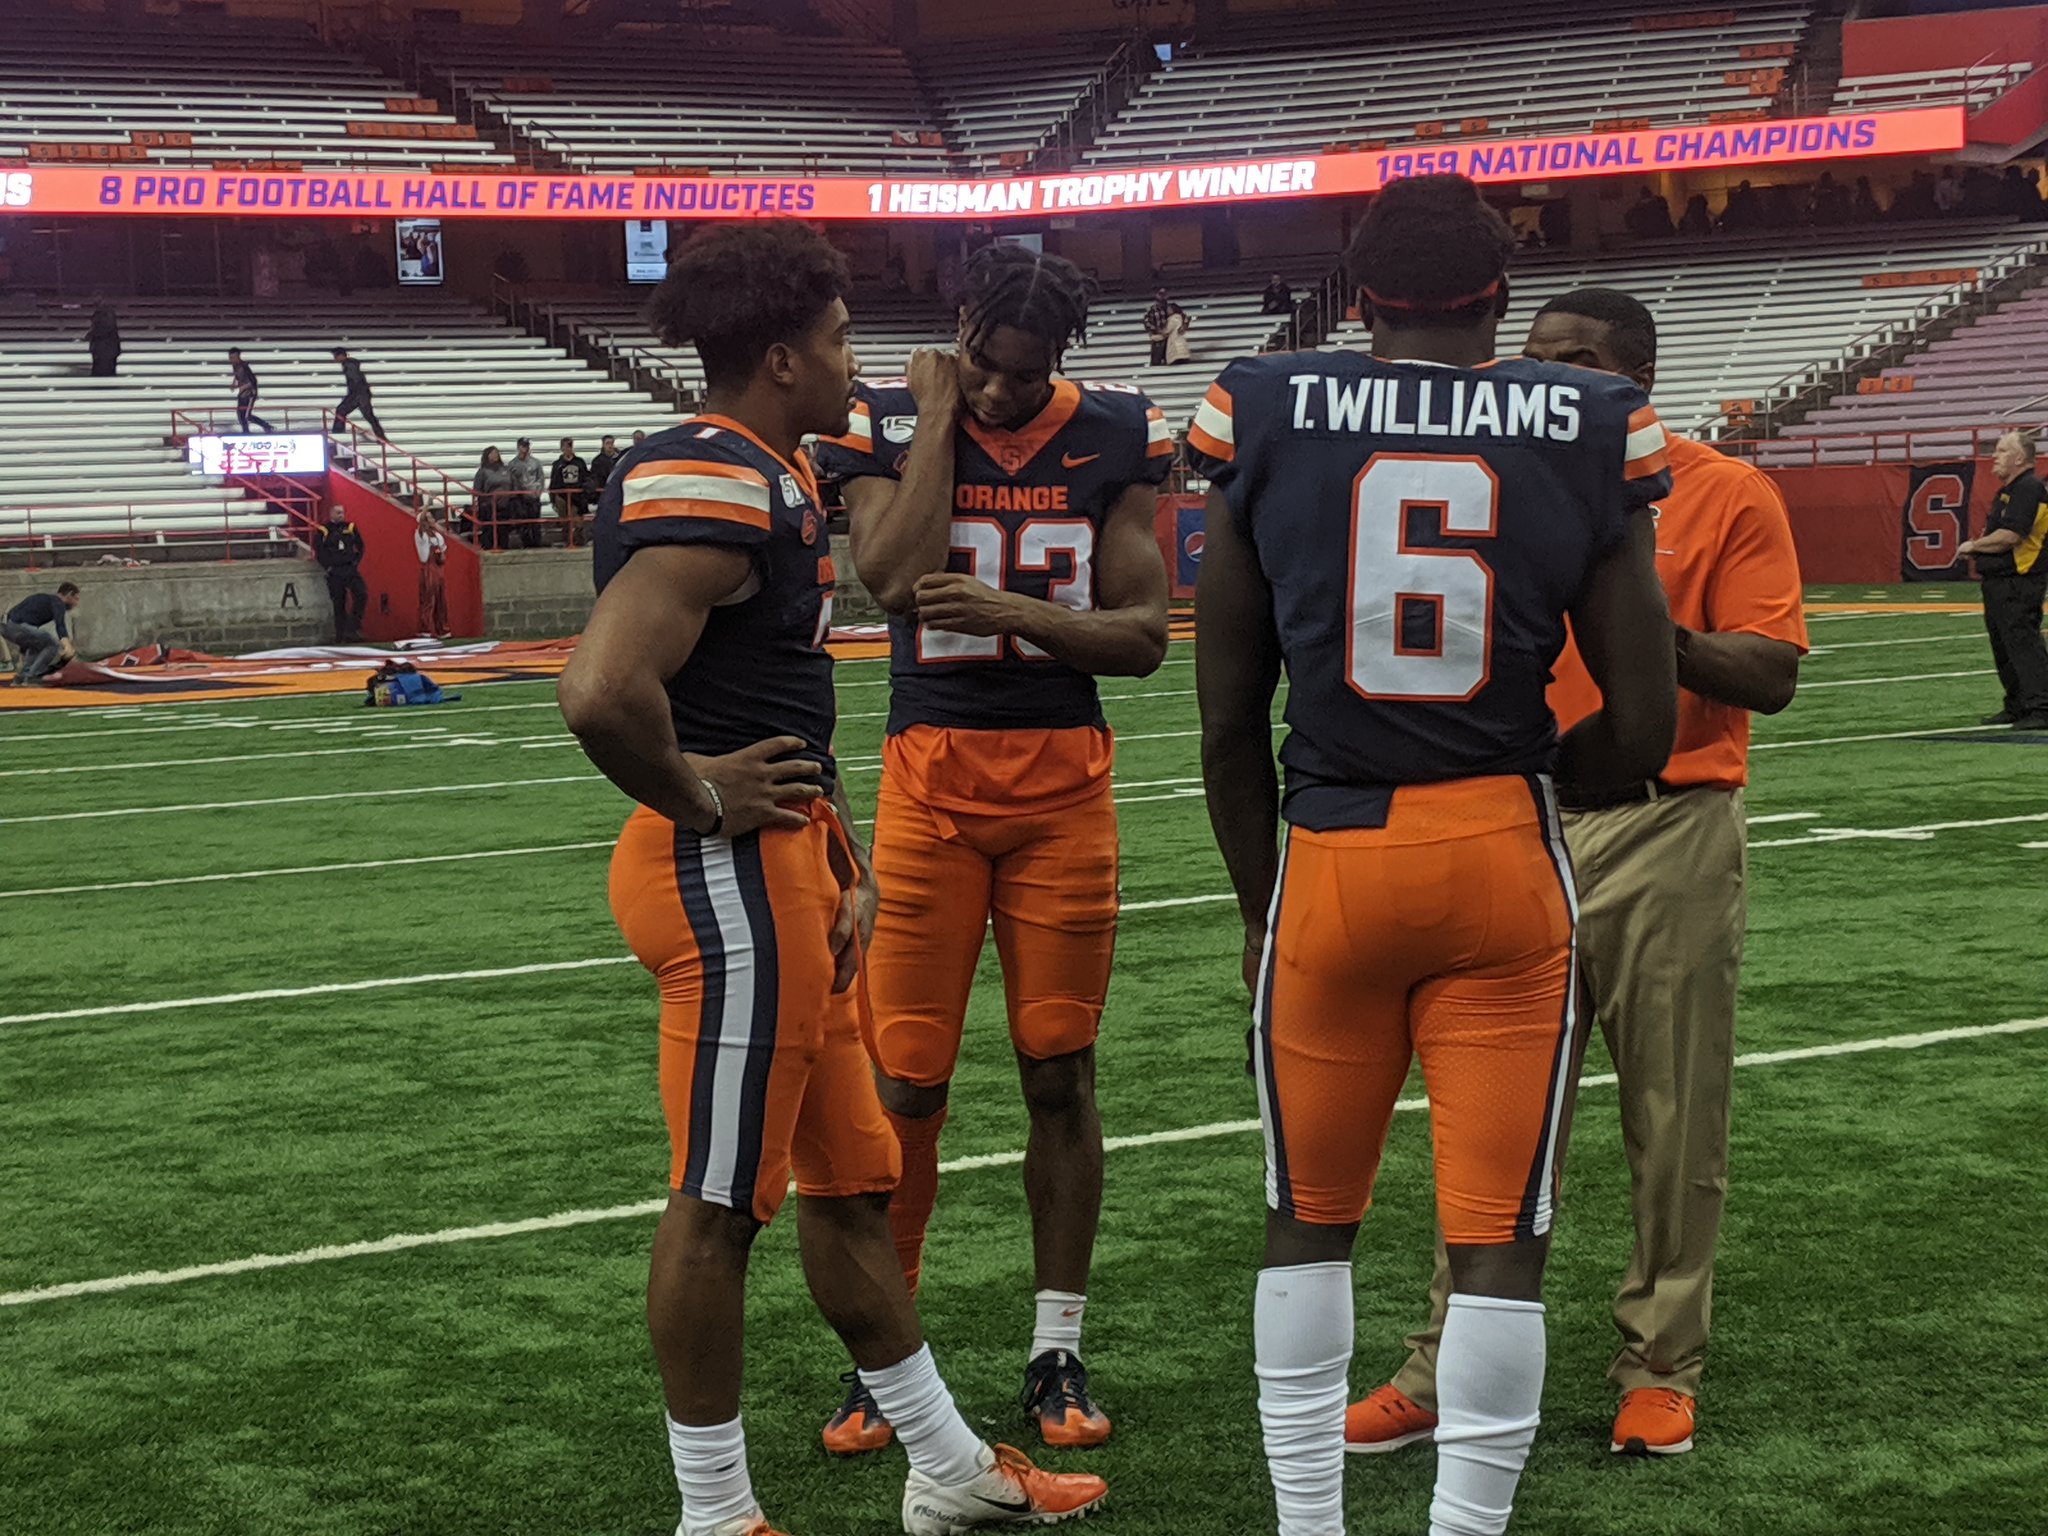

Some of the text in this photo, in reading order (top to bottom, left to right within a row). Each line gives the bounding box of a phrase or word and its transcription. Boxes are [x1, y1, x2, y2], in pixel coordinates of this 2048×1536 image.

[1376, 120, 1876, 182] 1959 NATIONAL CHAMPIONS
[100, 176, 814, 210] 8 PRO FOOTBALL HALL OF FAME INDUCTEES
[867, 161, 1315, 213] 1 HEISMAN TROPHY WINNER
[956, 484, 1069, 511] ORANGE
[1906, 474, 1964, 570] S
[281, 582, 299, 608] A
[1345, 451, 1500, 702] 6
